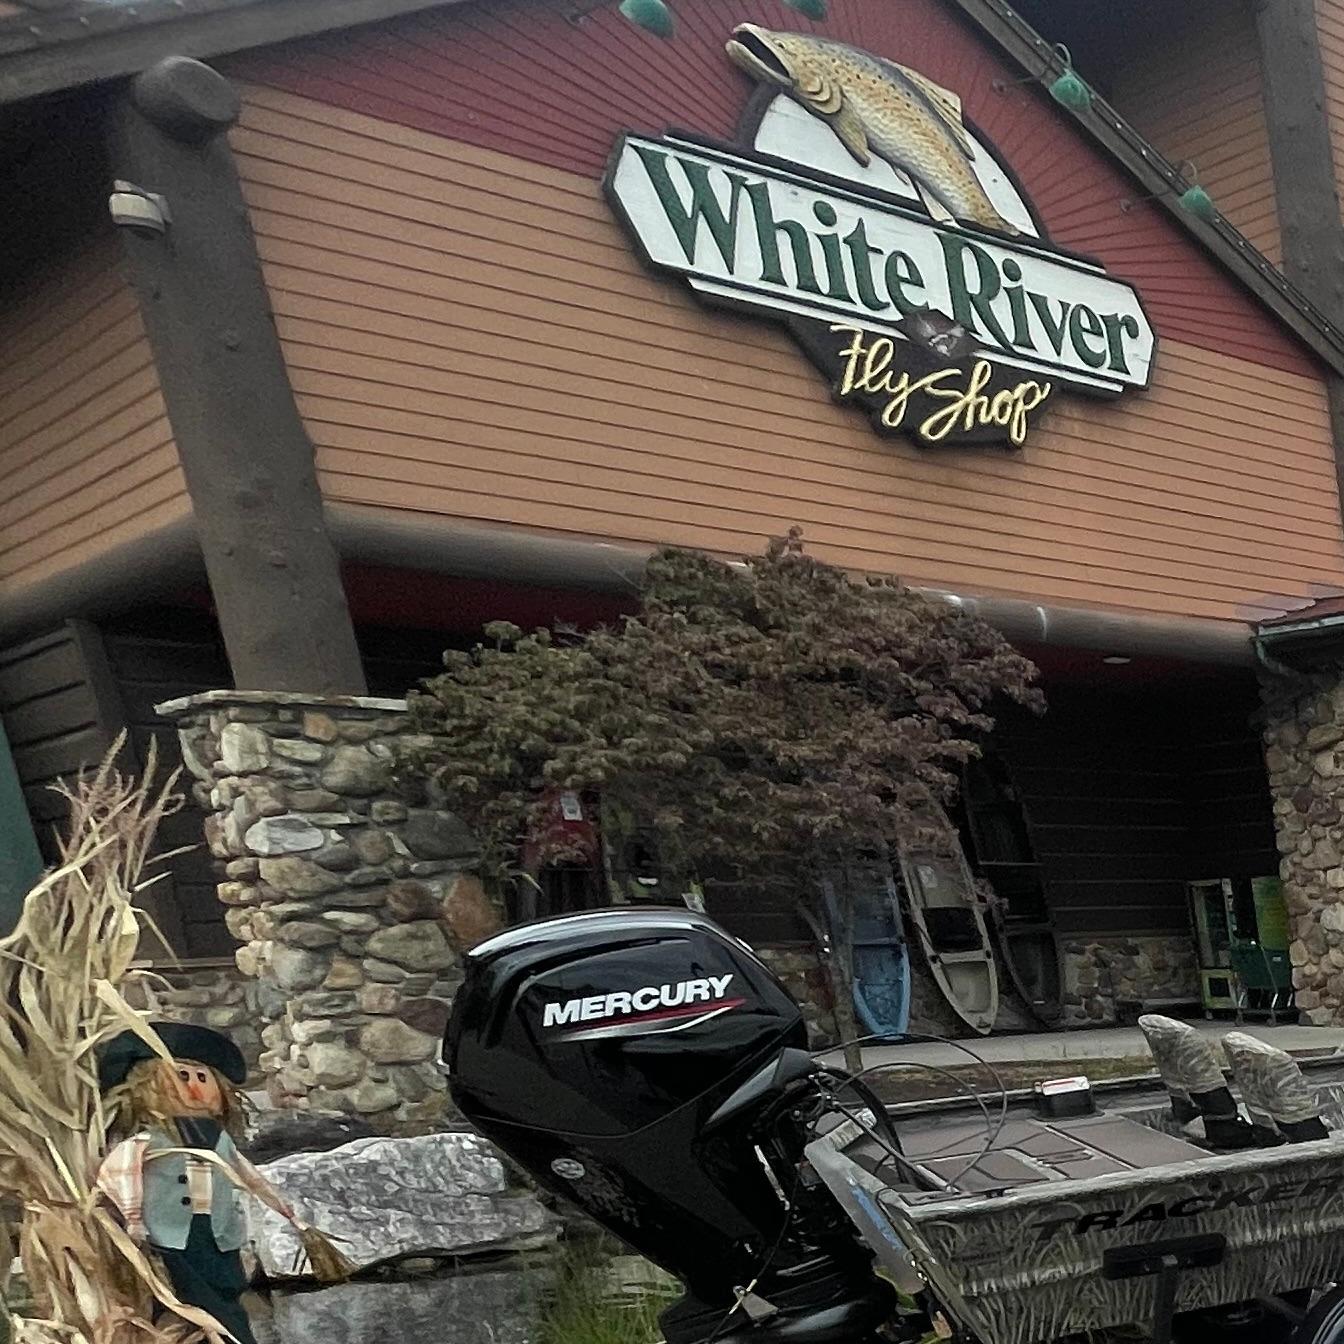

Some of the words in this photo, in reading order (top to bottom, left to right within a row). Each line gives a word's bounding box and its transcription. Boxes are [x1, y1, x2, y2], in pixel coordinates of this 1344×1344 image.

[629, 144, 929, 314] White
[934, 231, 1140, 376] River
[830, 323, 926, 426] Fly
[916, 359, 1050, 447] Shop
[543, 974, 733, 1027] MERCURY
